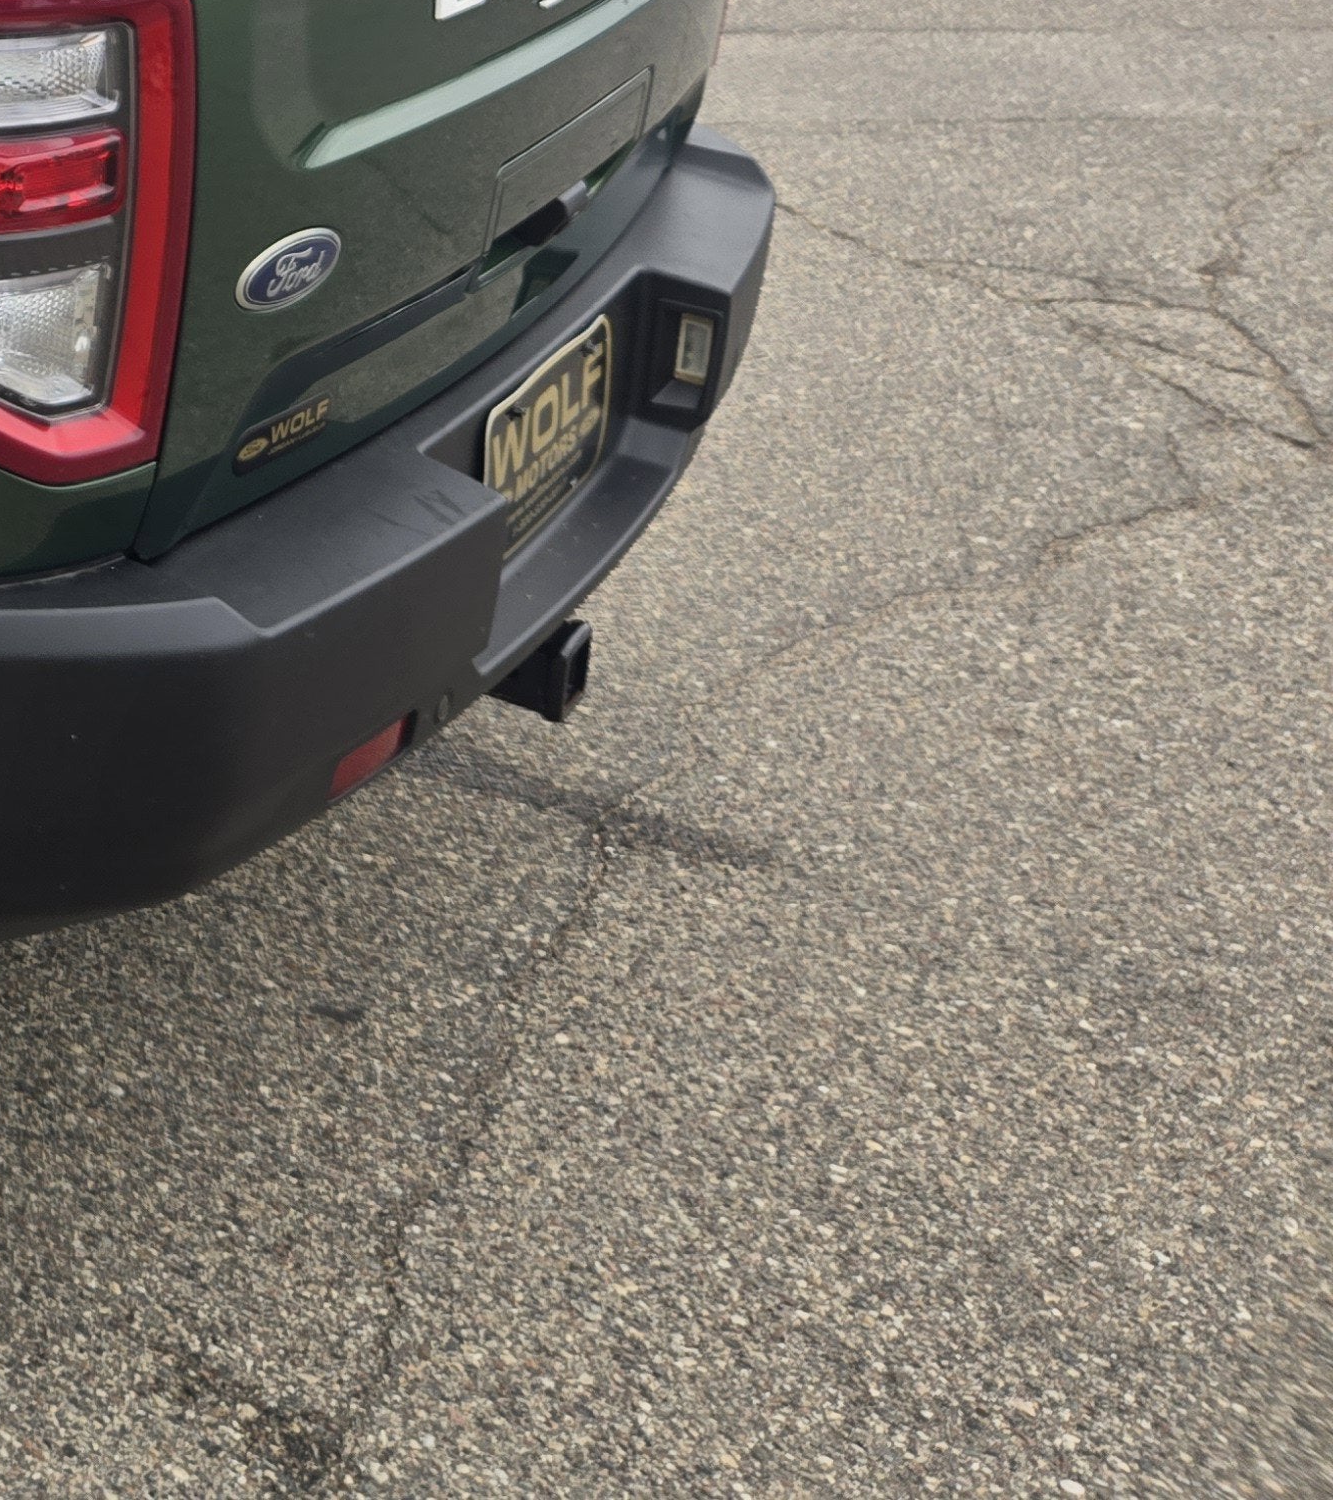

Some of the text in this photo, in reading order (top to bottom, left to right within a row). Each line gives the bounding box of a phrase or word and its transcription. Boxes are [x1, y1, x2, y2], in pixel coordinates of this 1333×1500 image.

[266, 247, 325, 297] Ford
[271, 399, 329, 443] WOLF
[493, 341, 603, 490] WOLF
[514, 424, 578, 501] MOTORS
